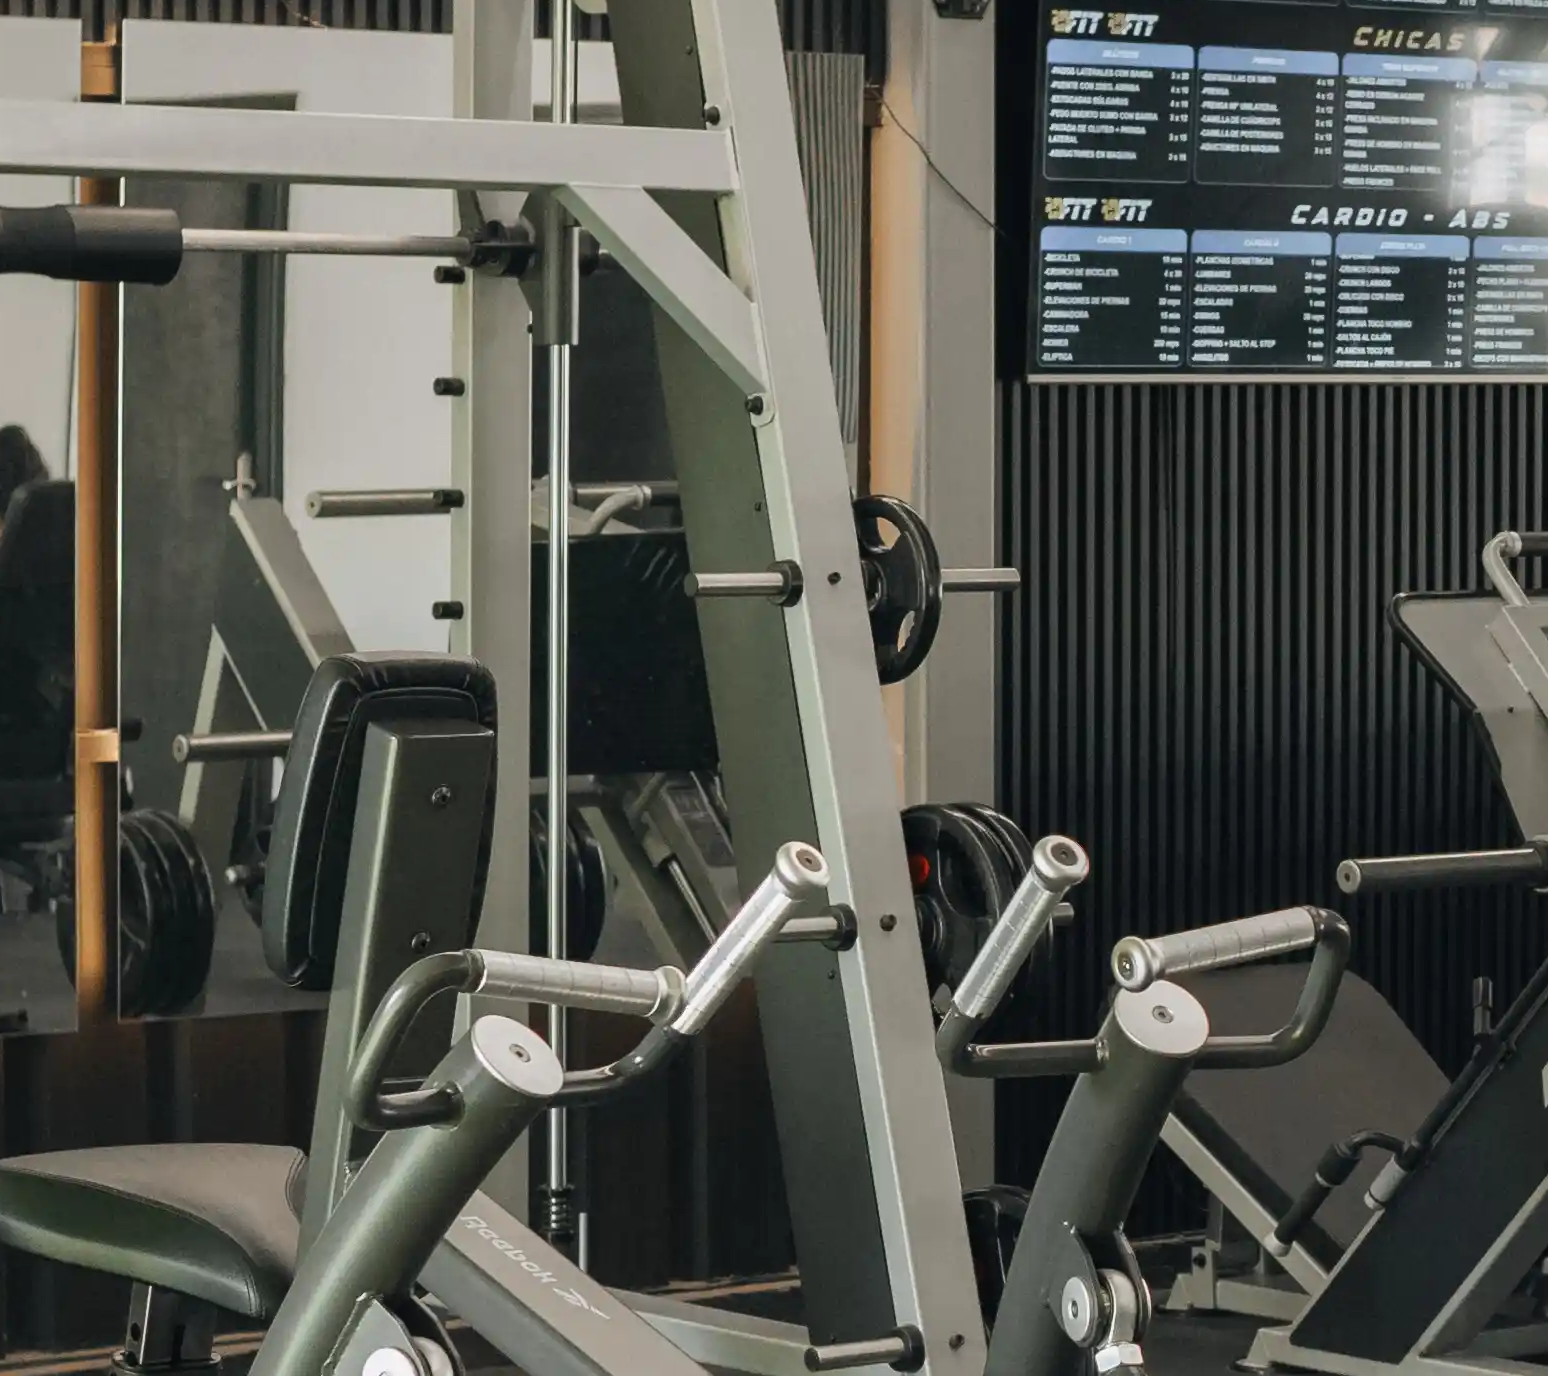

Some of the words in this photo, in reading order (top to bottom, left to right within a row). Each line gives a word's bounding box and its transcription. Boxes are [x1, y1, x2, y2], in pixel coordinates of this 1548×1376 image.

[1353, 26, 1466, 51] CHICAS
[1290, 204, 1408, 228] CARDIO
[1448, 208, 1511, 230] ABS
